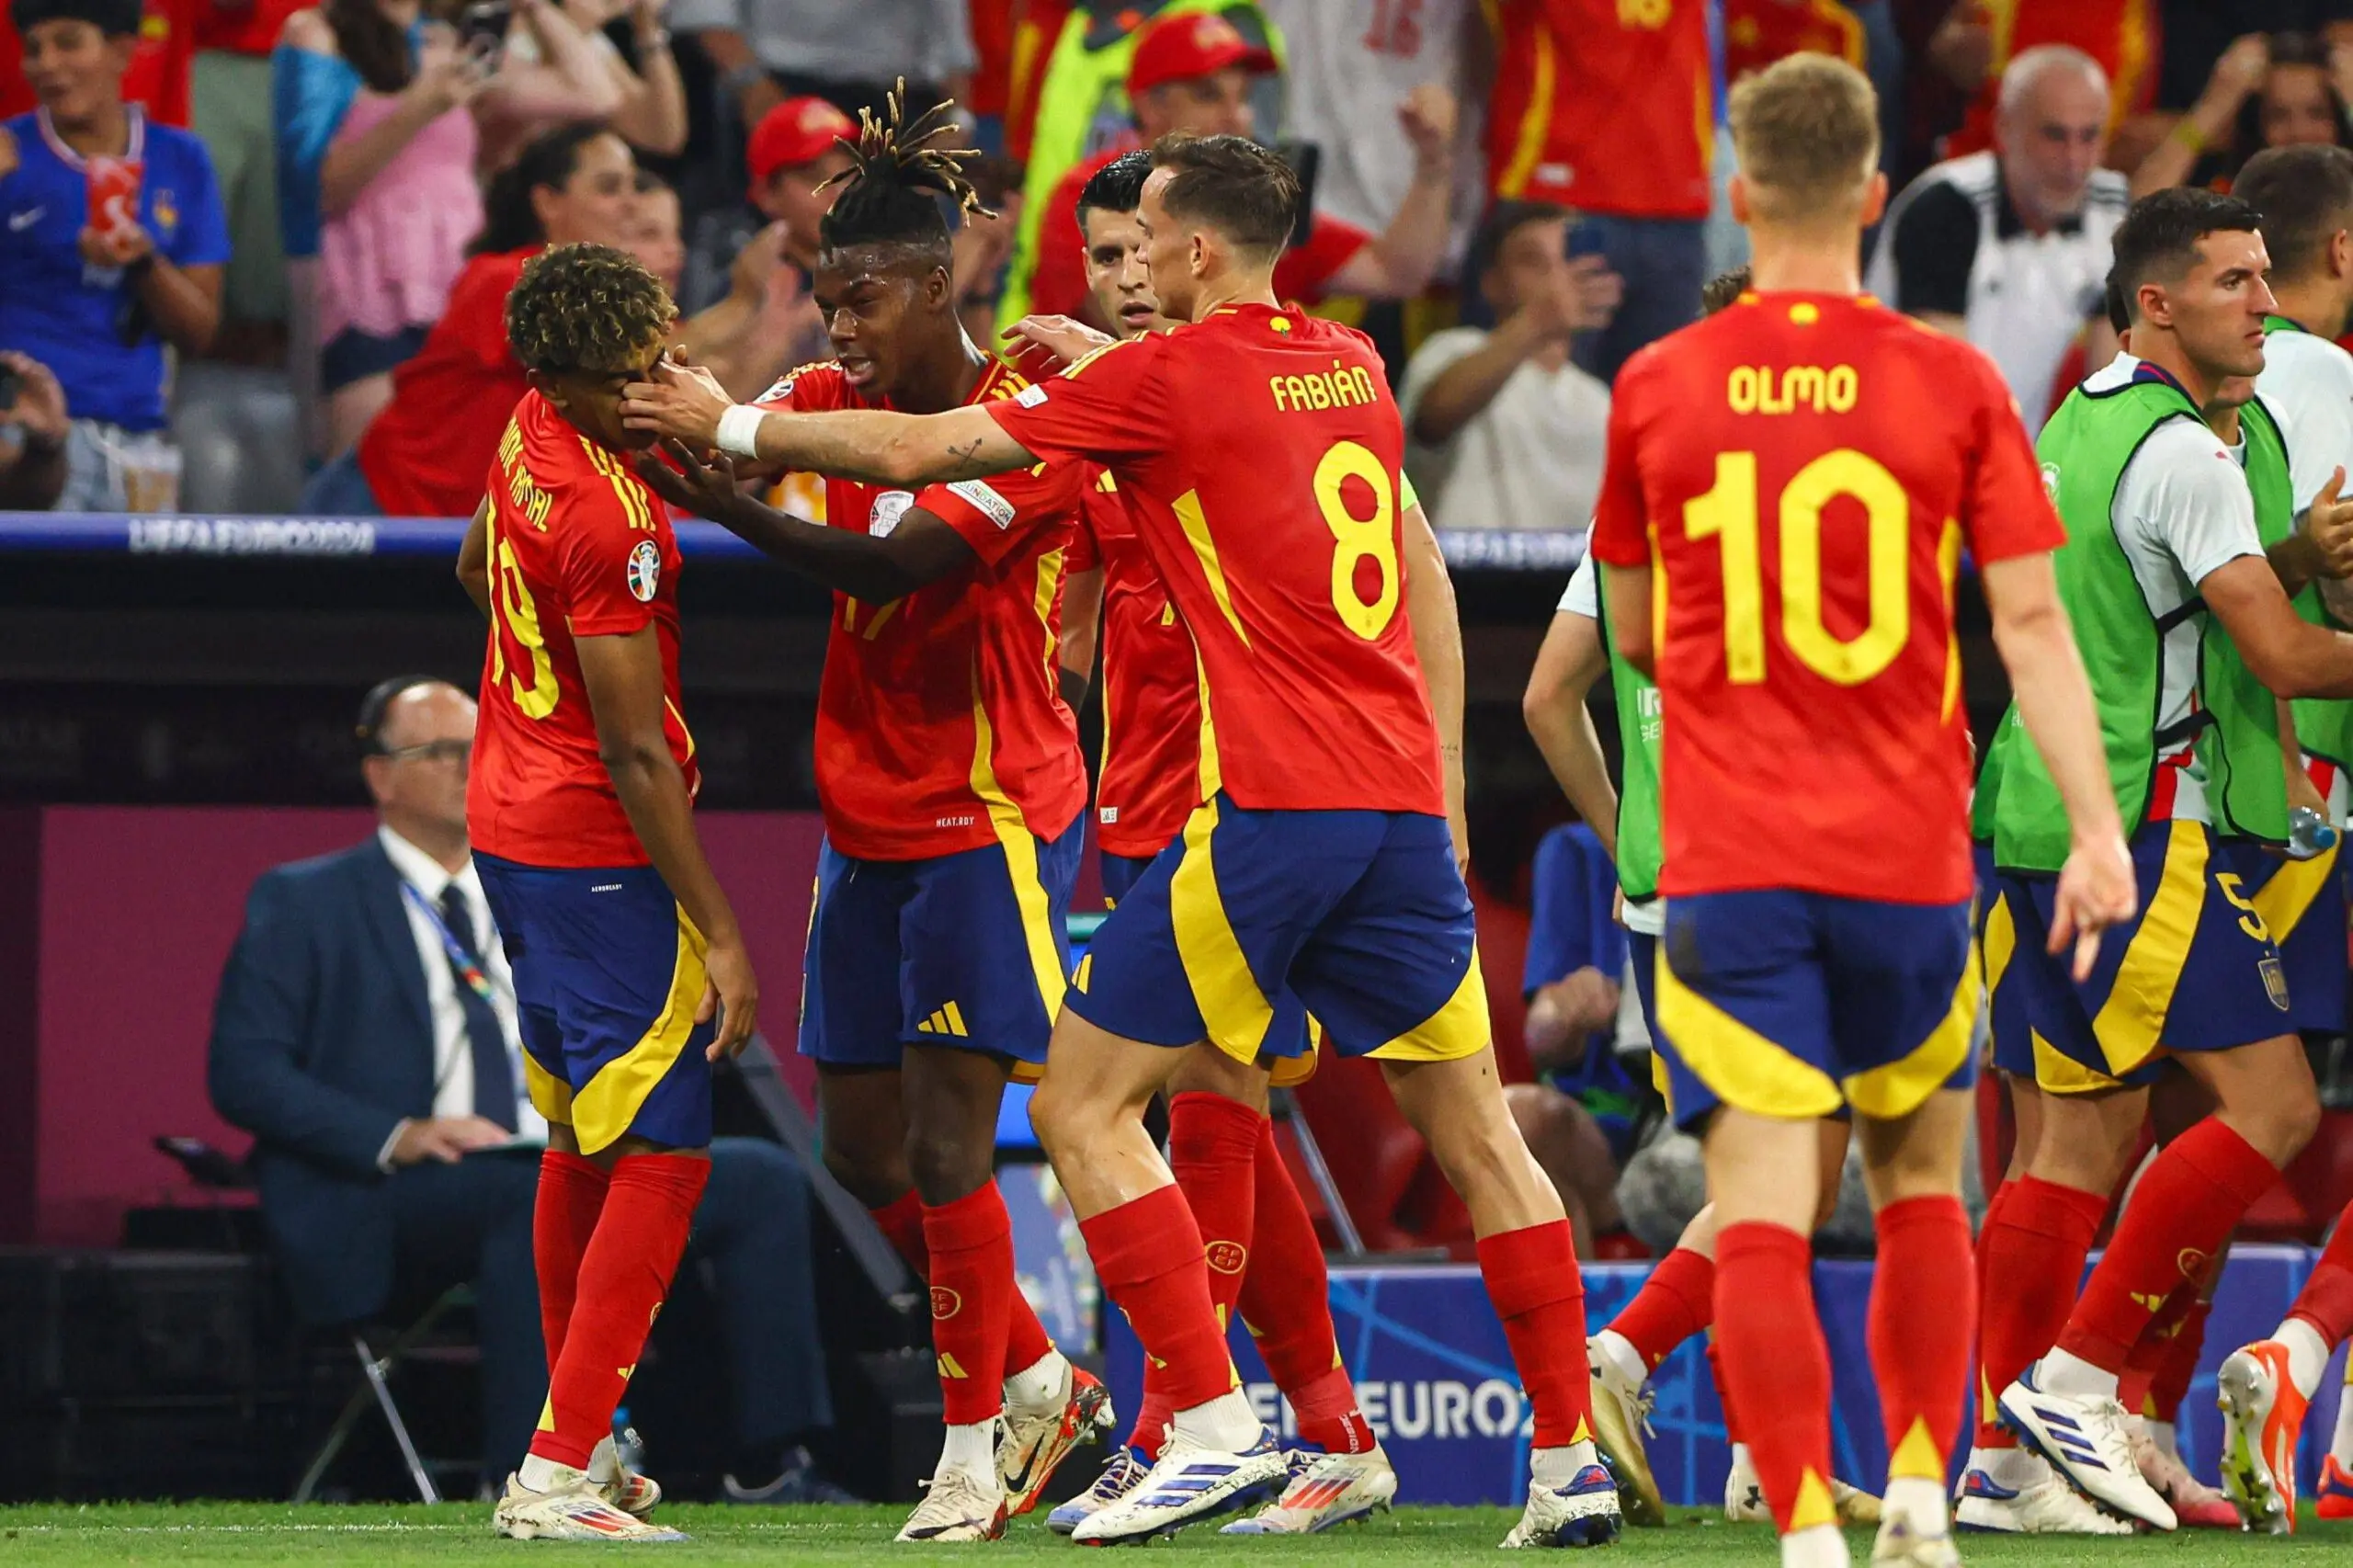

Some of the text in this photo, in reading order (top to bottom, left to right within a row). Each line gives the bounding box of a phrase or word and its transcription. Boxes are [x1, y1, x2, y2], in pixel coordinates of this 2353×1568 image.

[1269, 358, 1378, 412] FABIÁN
[1728, 364, 1859, 415] OLMO
[1313, 440, 1400, 642] 8
[1683, 448, 1909, 687] 10
[485, 489, 561, 721] 19
[936, 815, 975, 828] HEAT.RDY
[2215, 872, 2268, 942] 5
